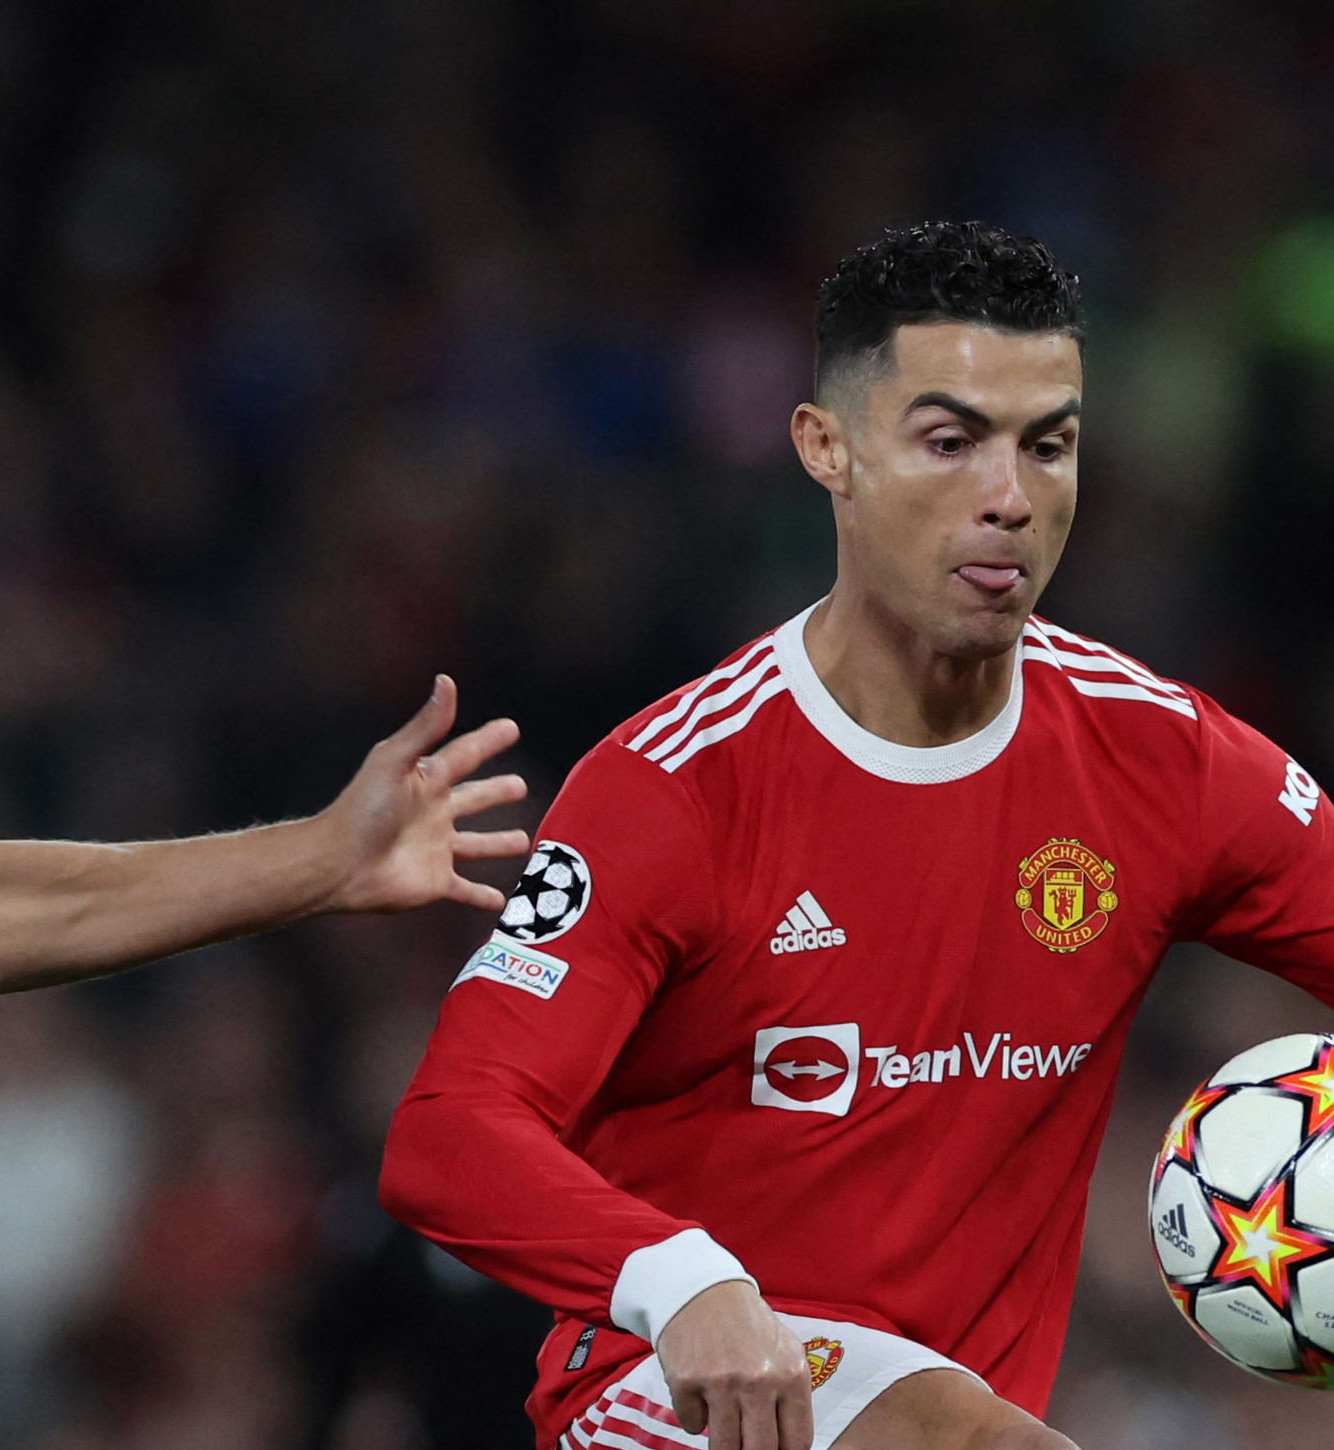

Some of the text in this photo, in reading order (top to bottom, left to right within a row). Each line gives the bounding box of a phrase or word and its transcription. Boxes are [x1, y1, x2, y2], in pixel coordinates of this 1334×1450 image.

[1277, 753, 1321, 827] KO
[1024, 846, 1107, 884] MANCHESTER
[770, 927, 847, 955] adidas
[1036, 926, 1092, 945] UNITED
[478, 947, 559, 985] DATION
[1158, 1221, 1196, 1258] adidas
